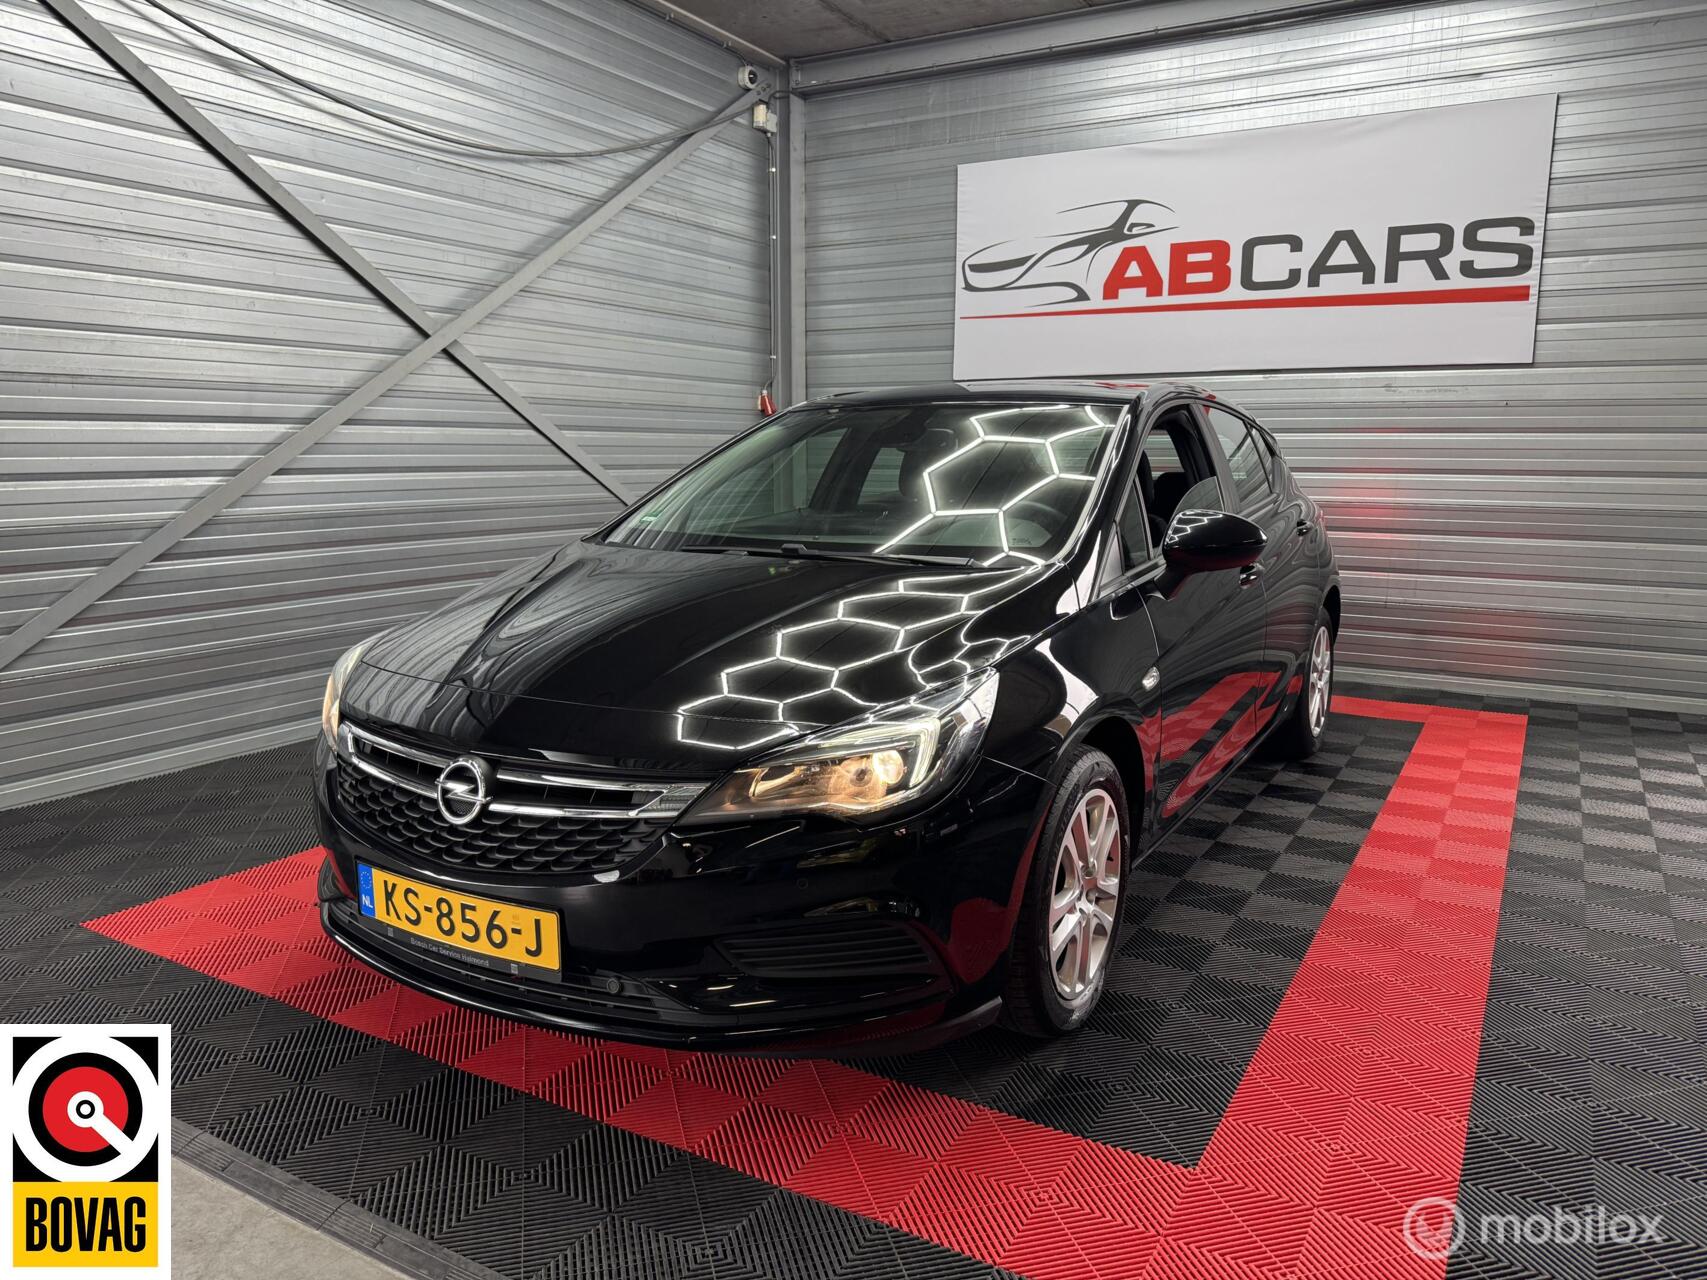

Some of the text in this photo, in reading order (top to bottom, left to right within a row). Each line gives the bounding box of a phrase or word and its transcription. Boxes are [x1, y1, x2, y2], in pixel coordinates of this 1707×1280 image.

[1102, 216, 1535, 300] ABCARS
[362, 894, 374, 909] NL
[383, 880, 542, 957] KS-856-J
[410, 937, 428, 949] Bosch
[440, 947, 461, 959] Service
